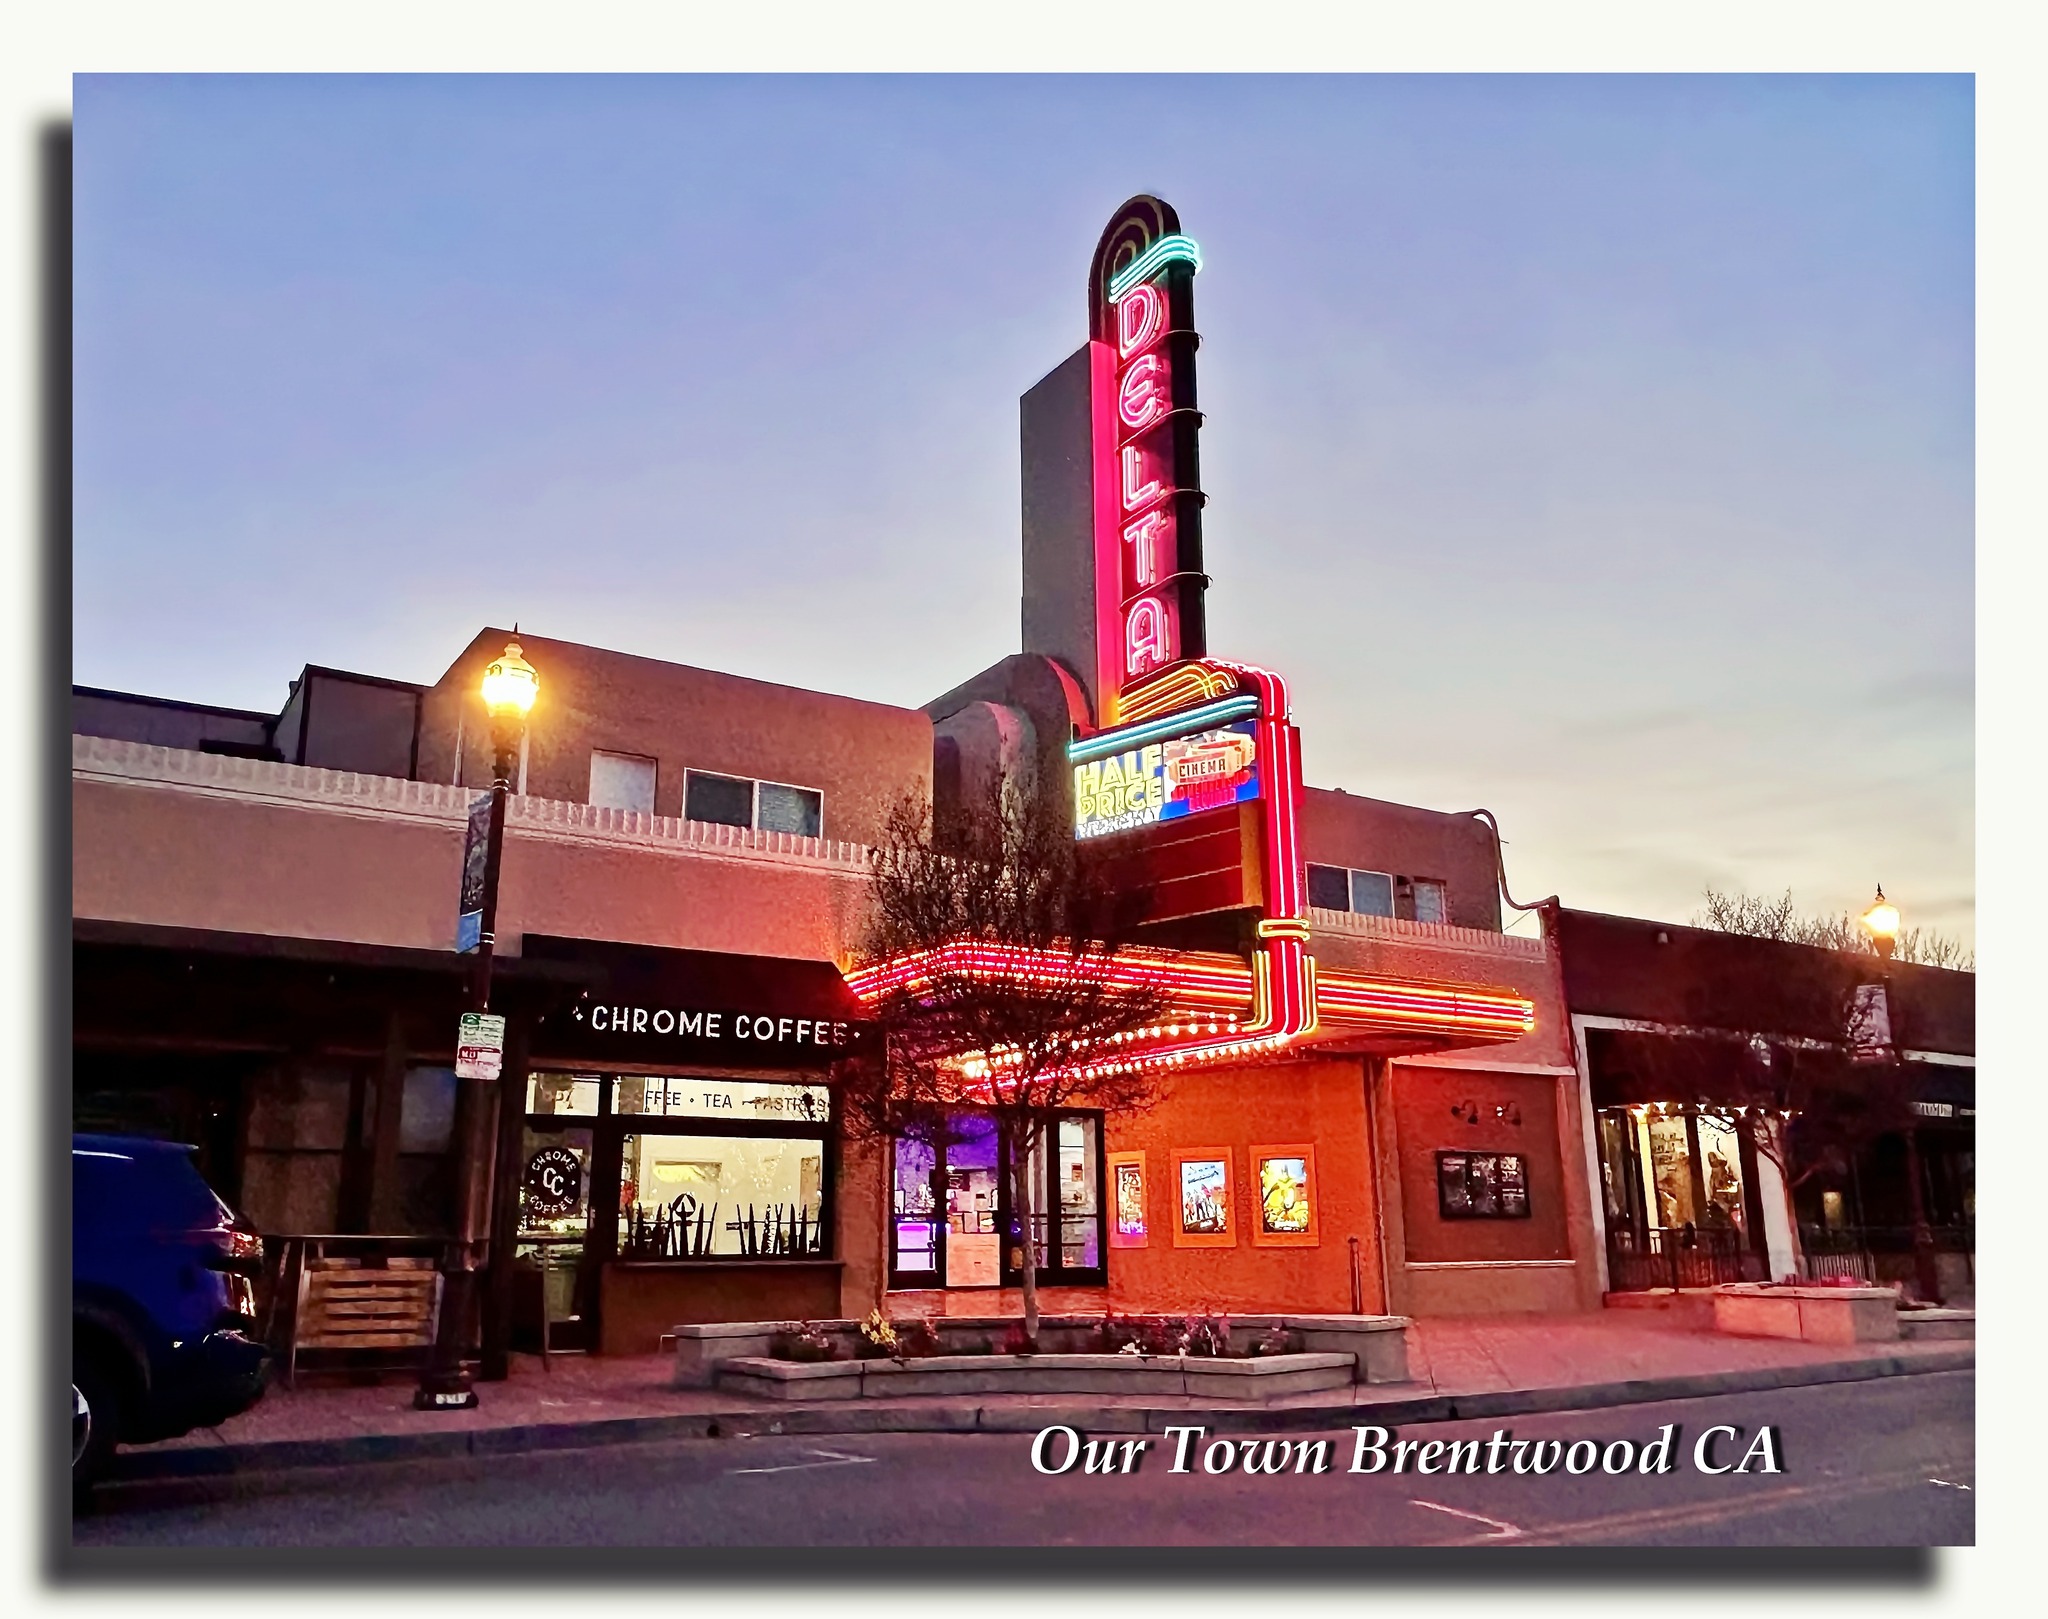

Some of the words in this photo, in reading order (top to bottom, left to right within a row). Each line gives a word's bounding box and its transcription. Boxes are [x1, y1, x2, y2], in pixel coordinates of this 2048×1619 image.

[1118, 284, 1167, 674] DELTA
[1075, 743, 1162, 795] HALF
[1179, 758, 1226, 777] CINEMA
[1075, 777, 1162, 823] PRICE
[591, 1005, 722, 1038] CHROME
[735, 1014, 848, 1046] COFFEE
[703, 1093, 733, 1109] TEA
[531, 1150, 577, 1173] CHROME
[542, 1167, 565, 1196] CC
[529, 1195, 574, 1214] COFFEE
